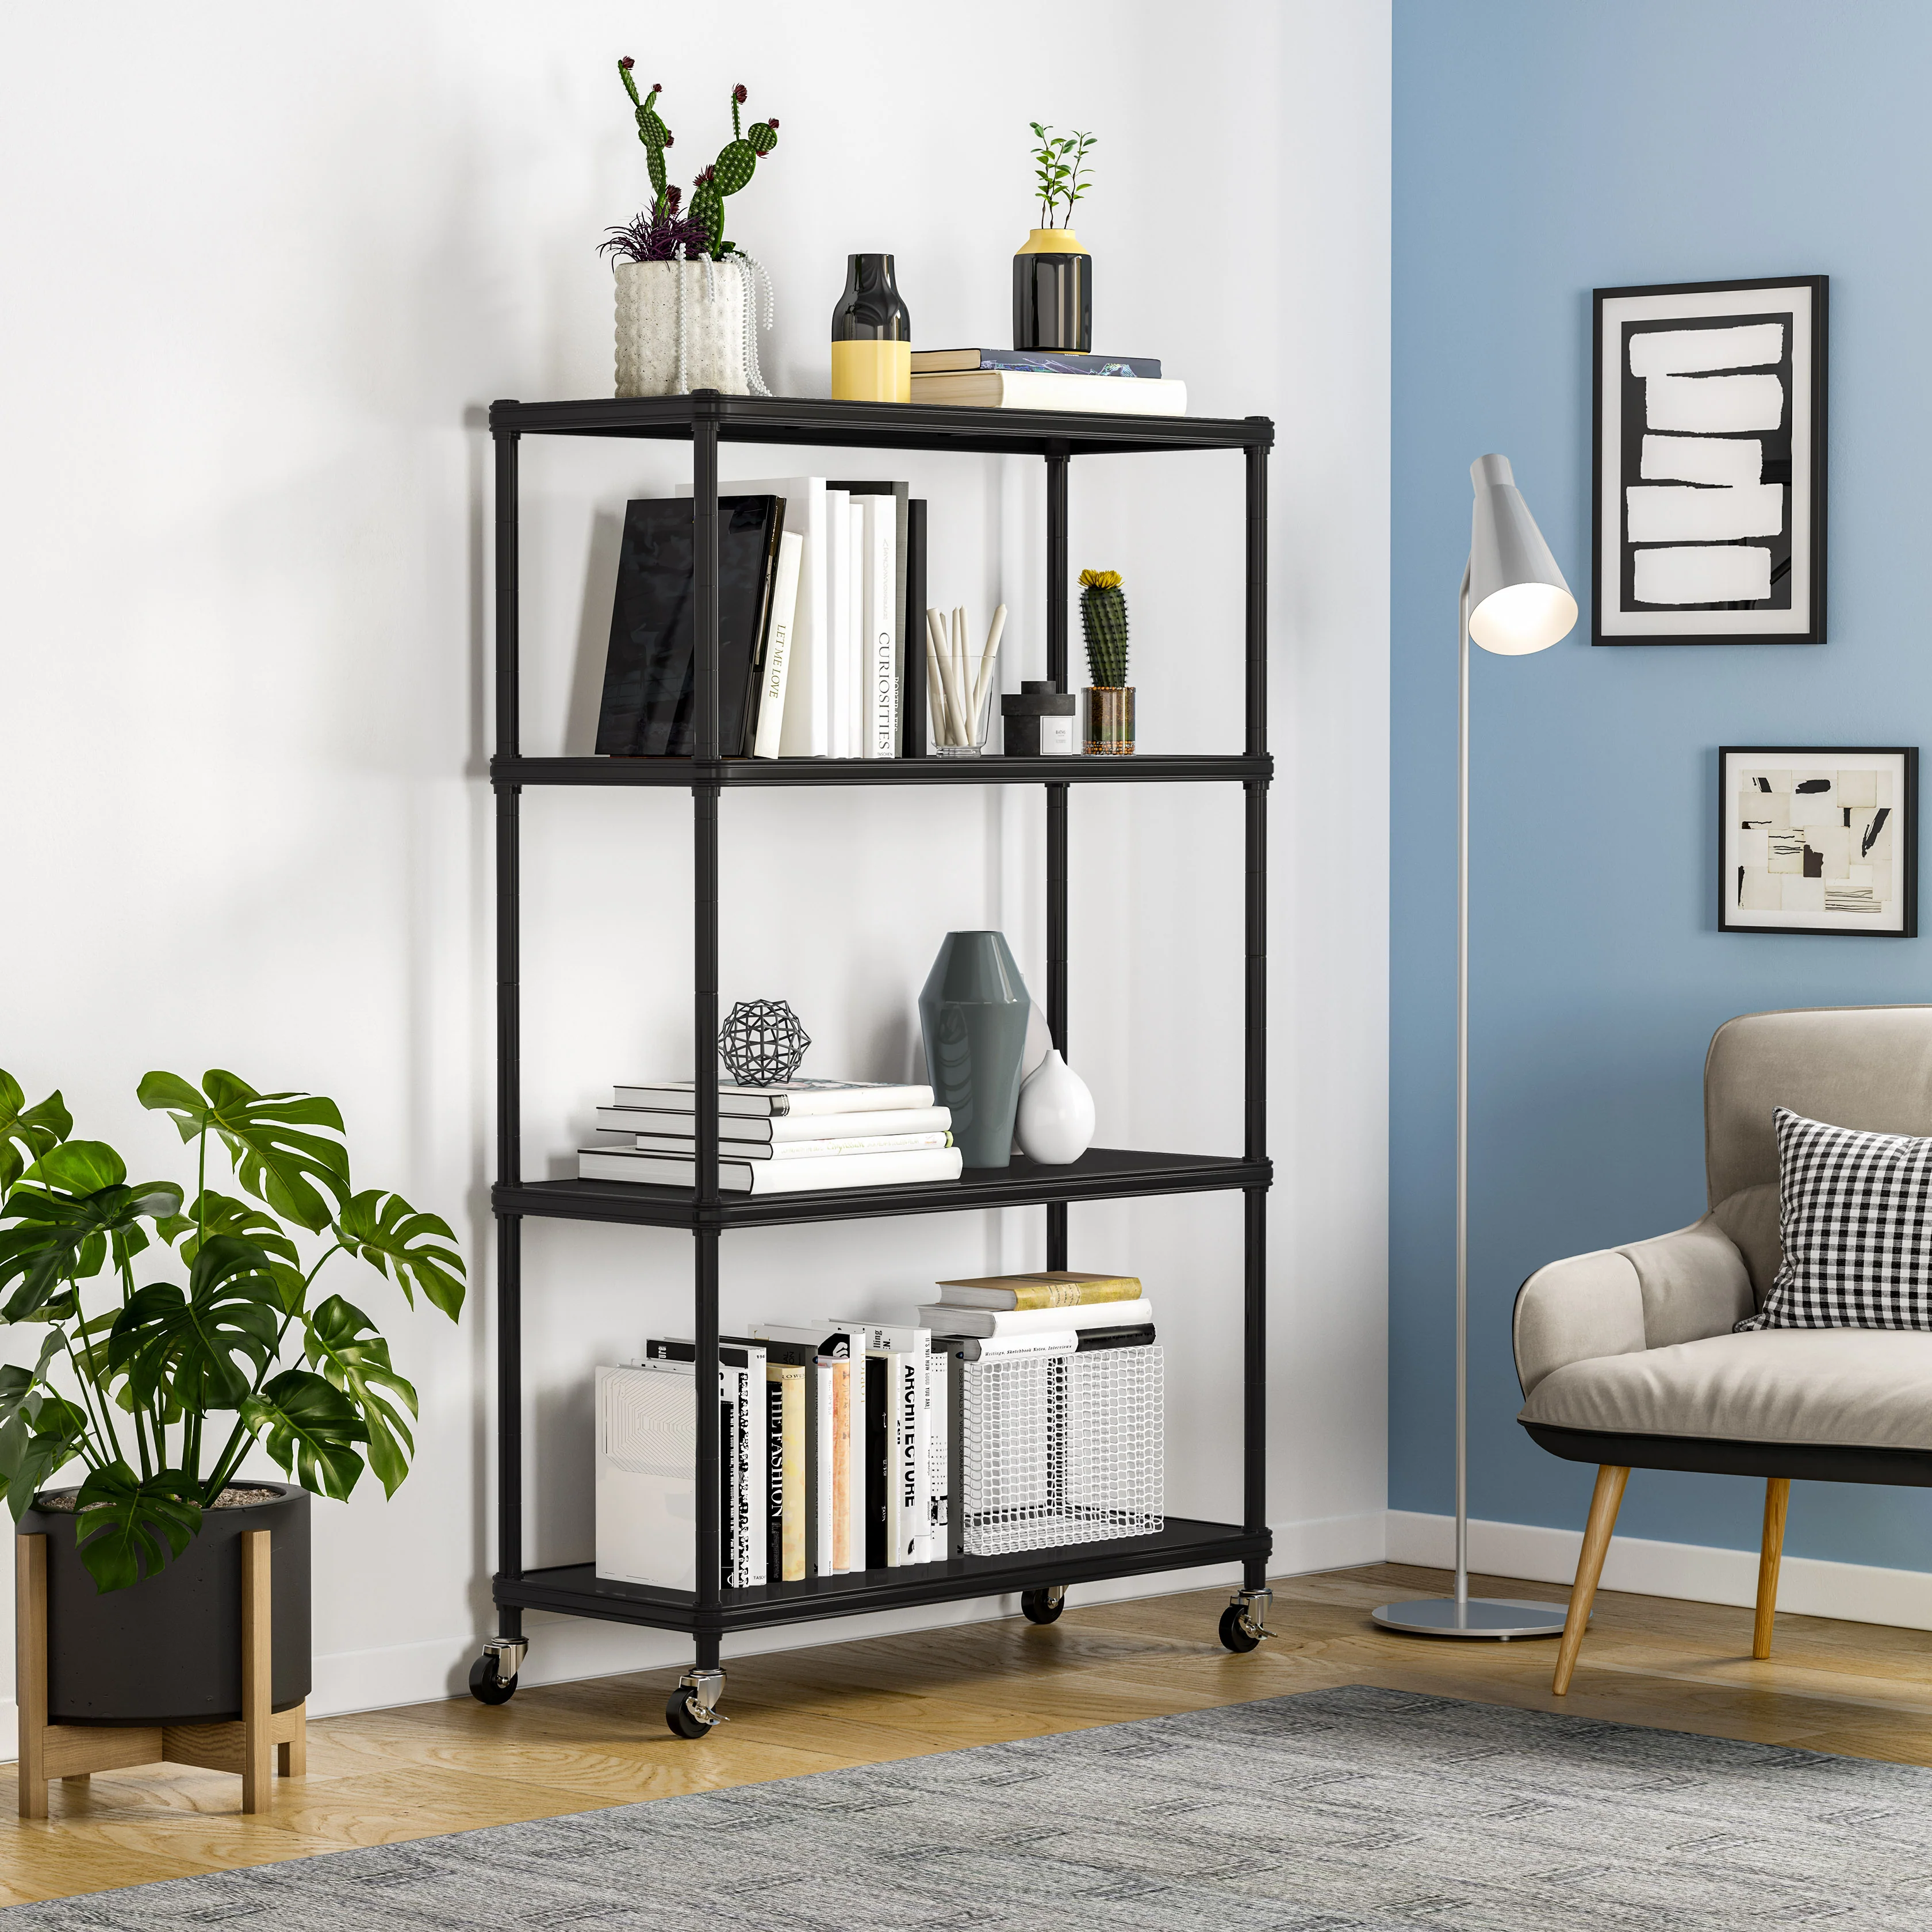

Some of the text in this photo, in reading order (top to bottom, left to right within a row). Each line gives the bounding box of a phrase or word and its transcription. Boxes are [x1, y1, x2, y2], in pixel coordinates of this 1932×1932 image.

[769, 624, 786, 699] LET ME LOVE
[879, 632, 890, 750] CURIOSITIES
[772, 1386, 782, 1428] THE
[904, 1365, 915, 1507] ARCHITECTURE
[959, 1409, 964, 1419] OF
[772, 1432, 782, 1517] FASHION
